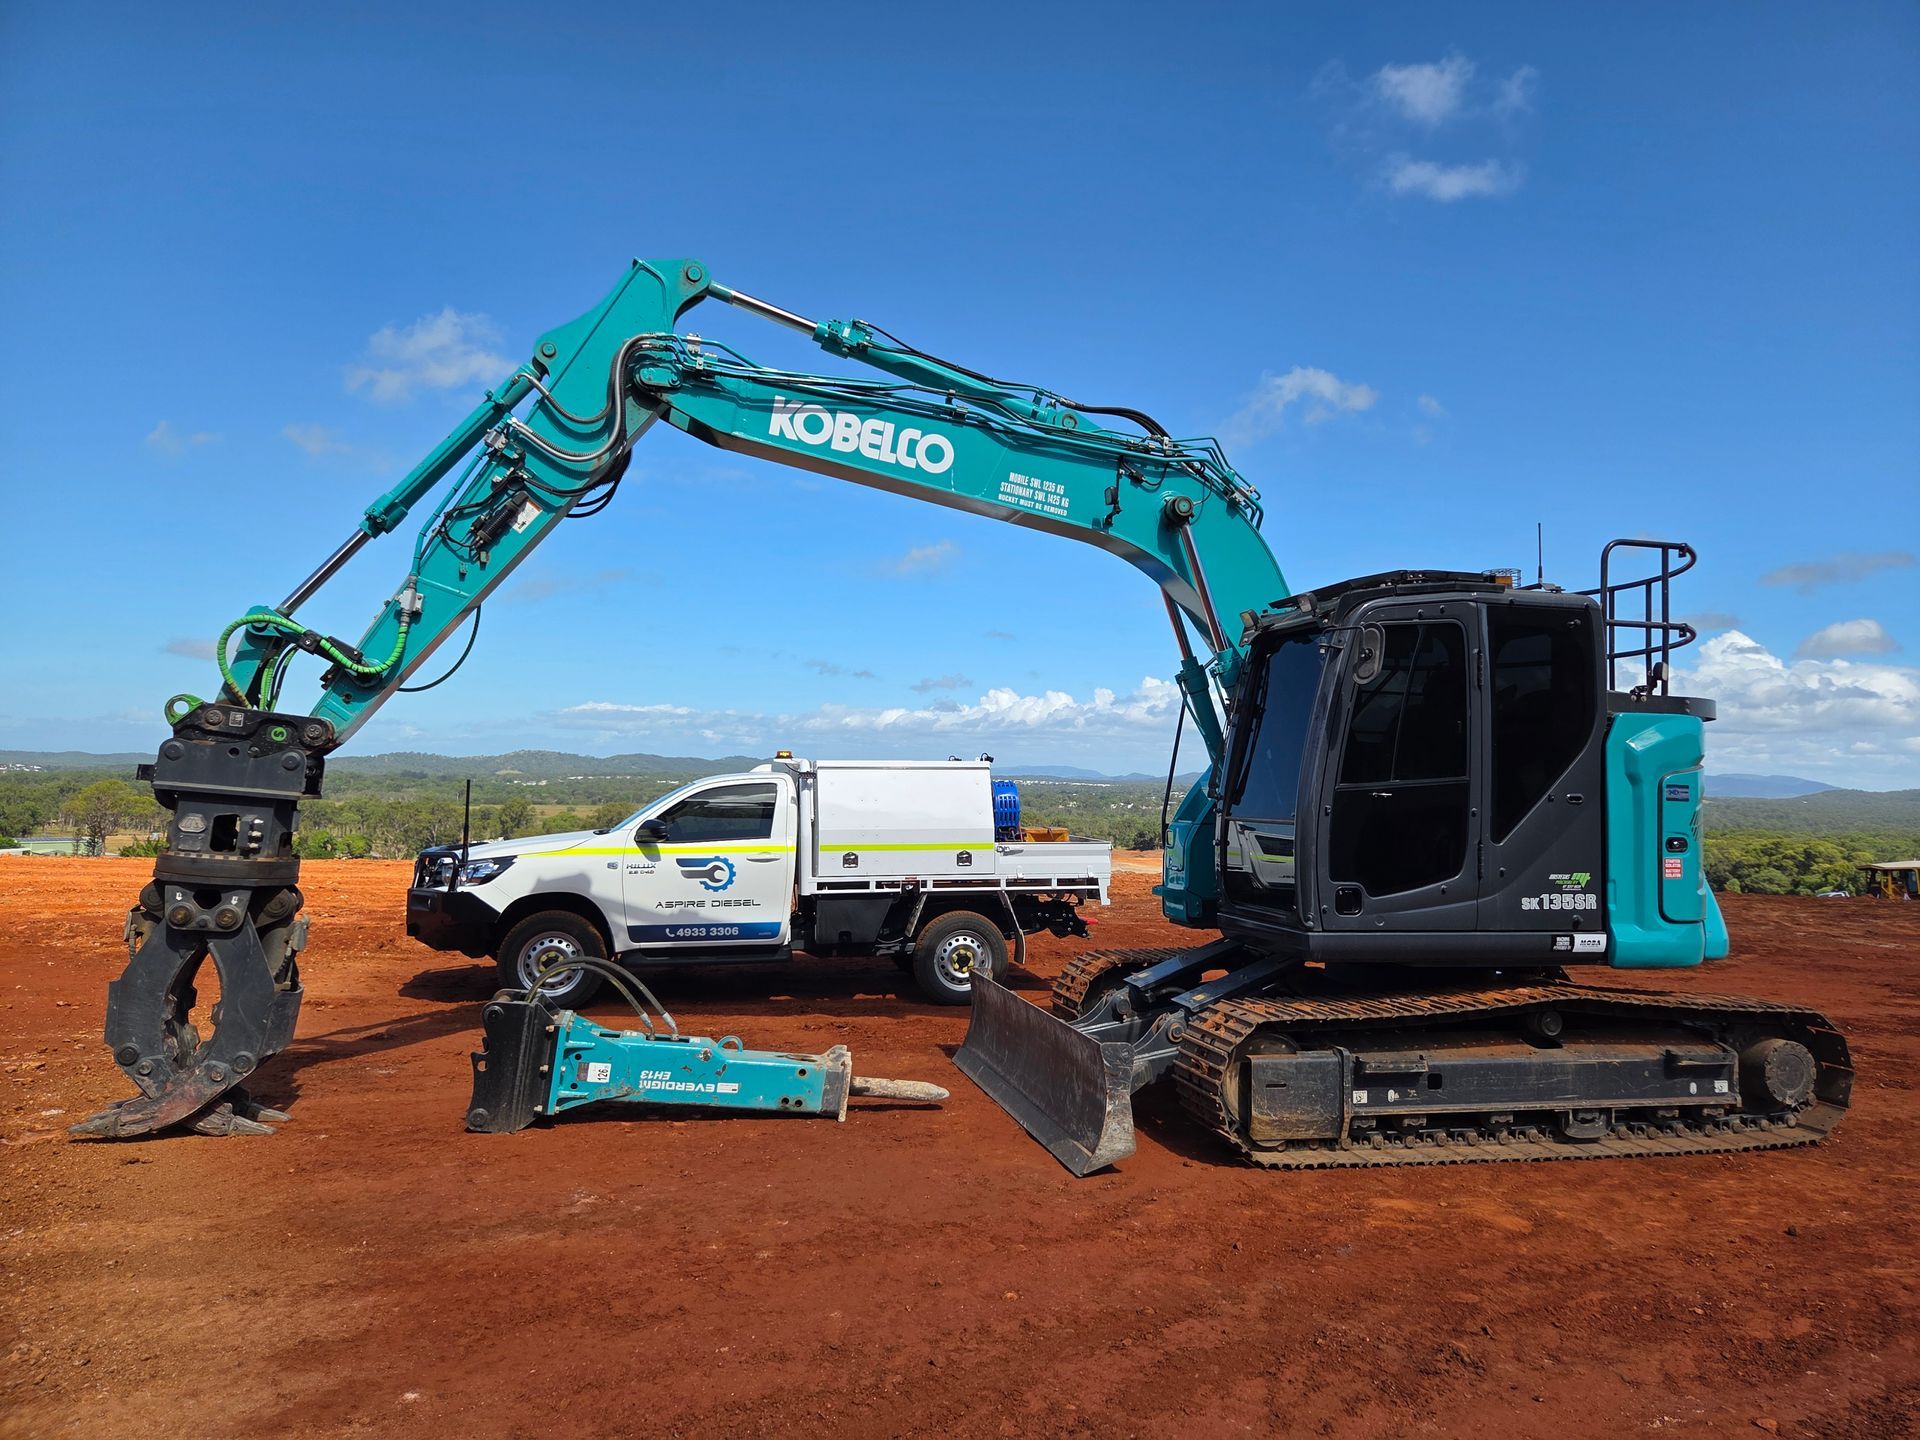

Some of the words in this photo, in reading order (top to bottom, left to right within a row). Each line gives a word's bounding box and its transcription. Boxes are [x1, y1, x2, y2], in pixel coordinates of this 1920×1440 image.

[768, 395, 955, 474] KOBELCO
[1009, 472, 1029, 486] MOBILE
[1030, 477, 1041, 489] SWL
[1043, 480, 1056, 492] 1235
[1056, 484, 1065, 495] KG
[1000, 482, 1033, 498] STATIONARY
[1034, 490, 1046, 502] SWL
[1047, 494, 1060, 506] 1425
[1061, 497, 1070, 508] KG
[1019, 499, 1034, 508] MUST
[1035, 503, 1043, 511] BE
[1043, 505, 1068, 517] REMOVED
[655, 901, 706, 909] ASPIRE
[711, 899, 761, 908] DIESEL
[676, 927, 706, 937] 4933
[709, 926, 739, 936] 3306
[597, 1068, 609, 1081] 126
[640, 1070, 672, 1080] EH13
